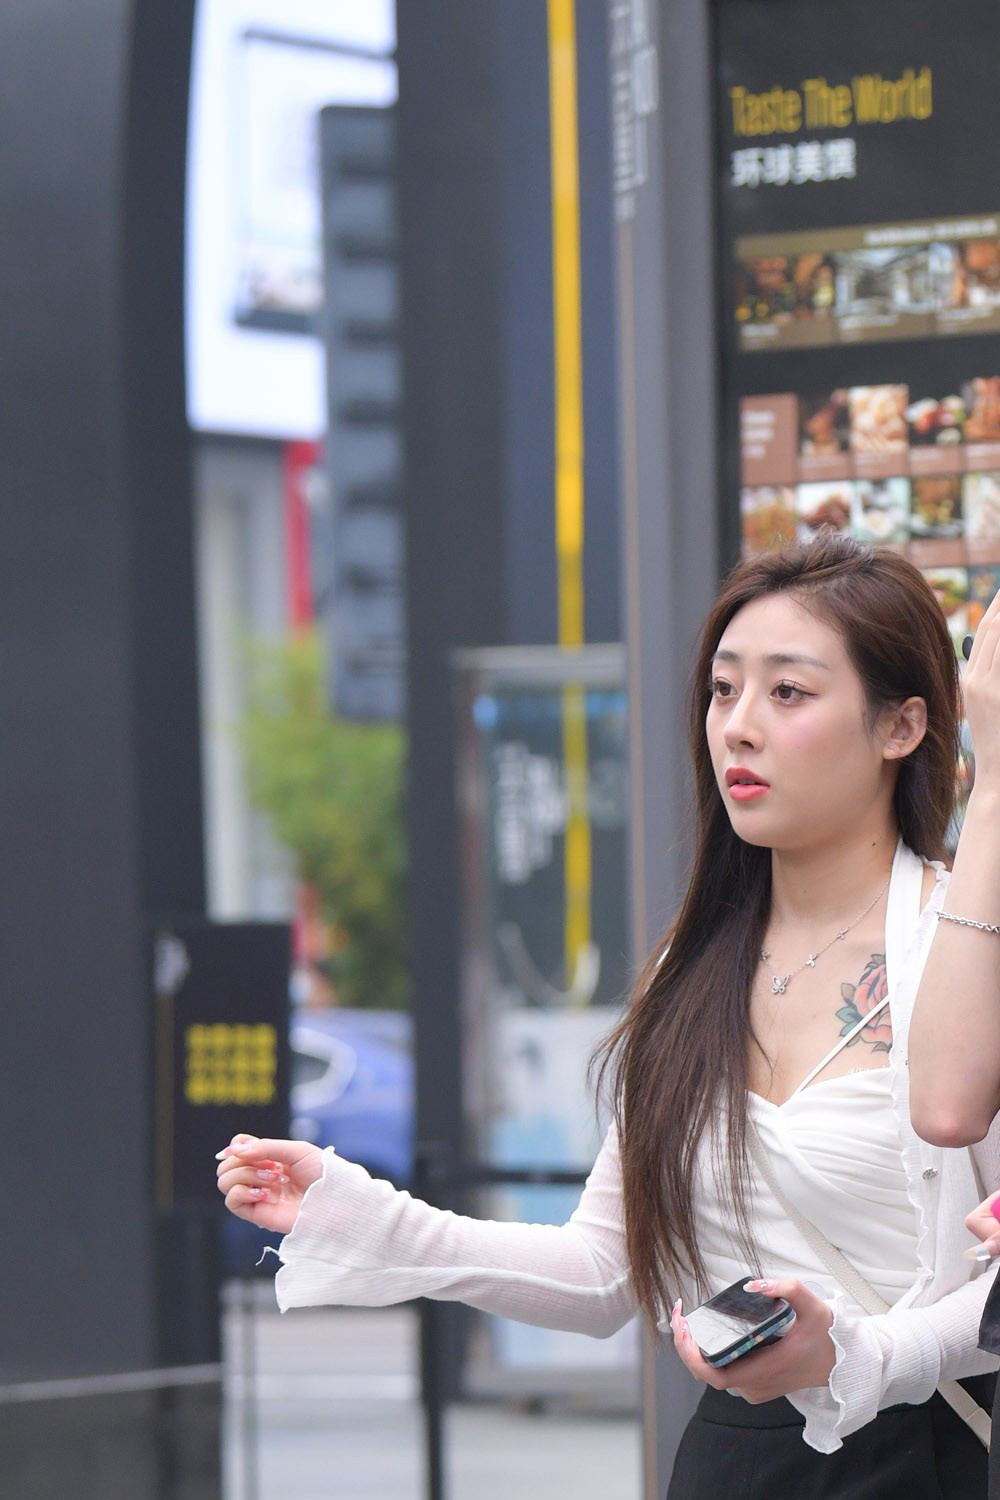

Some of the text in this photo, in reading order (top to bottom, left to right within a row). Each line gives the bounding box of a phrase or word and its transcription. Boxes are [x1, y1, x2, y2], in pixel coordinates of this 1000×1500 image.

[731, 67, 932, 136] Taste The World
